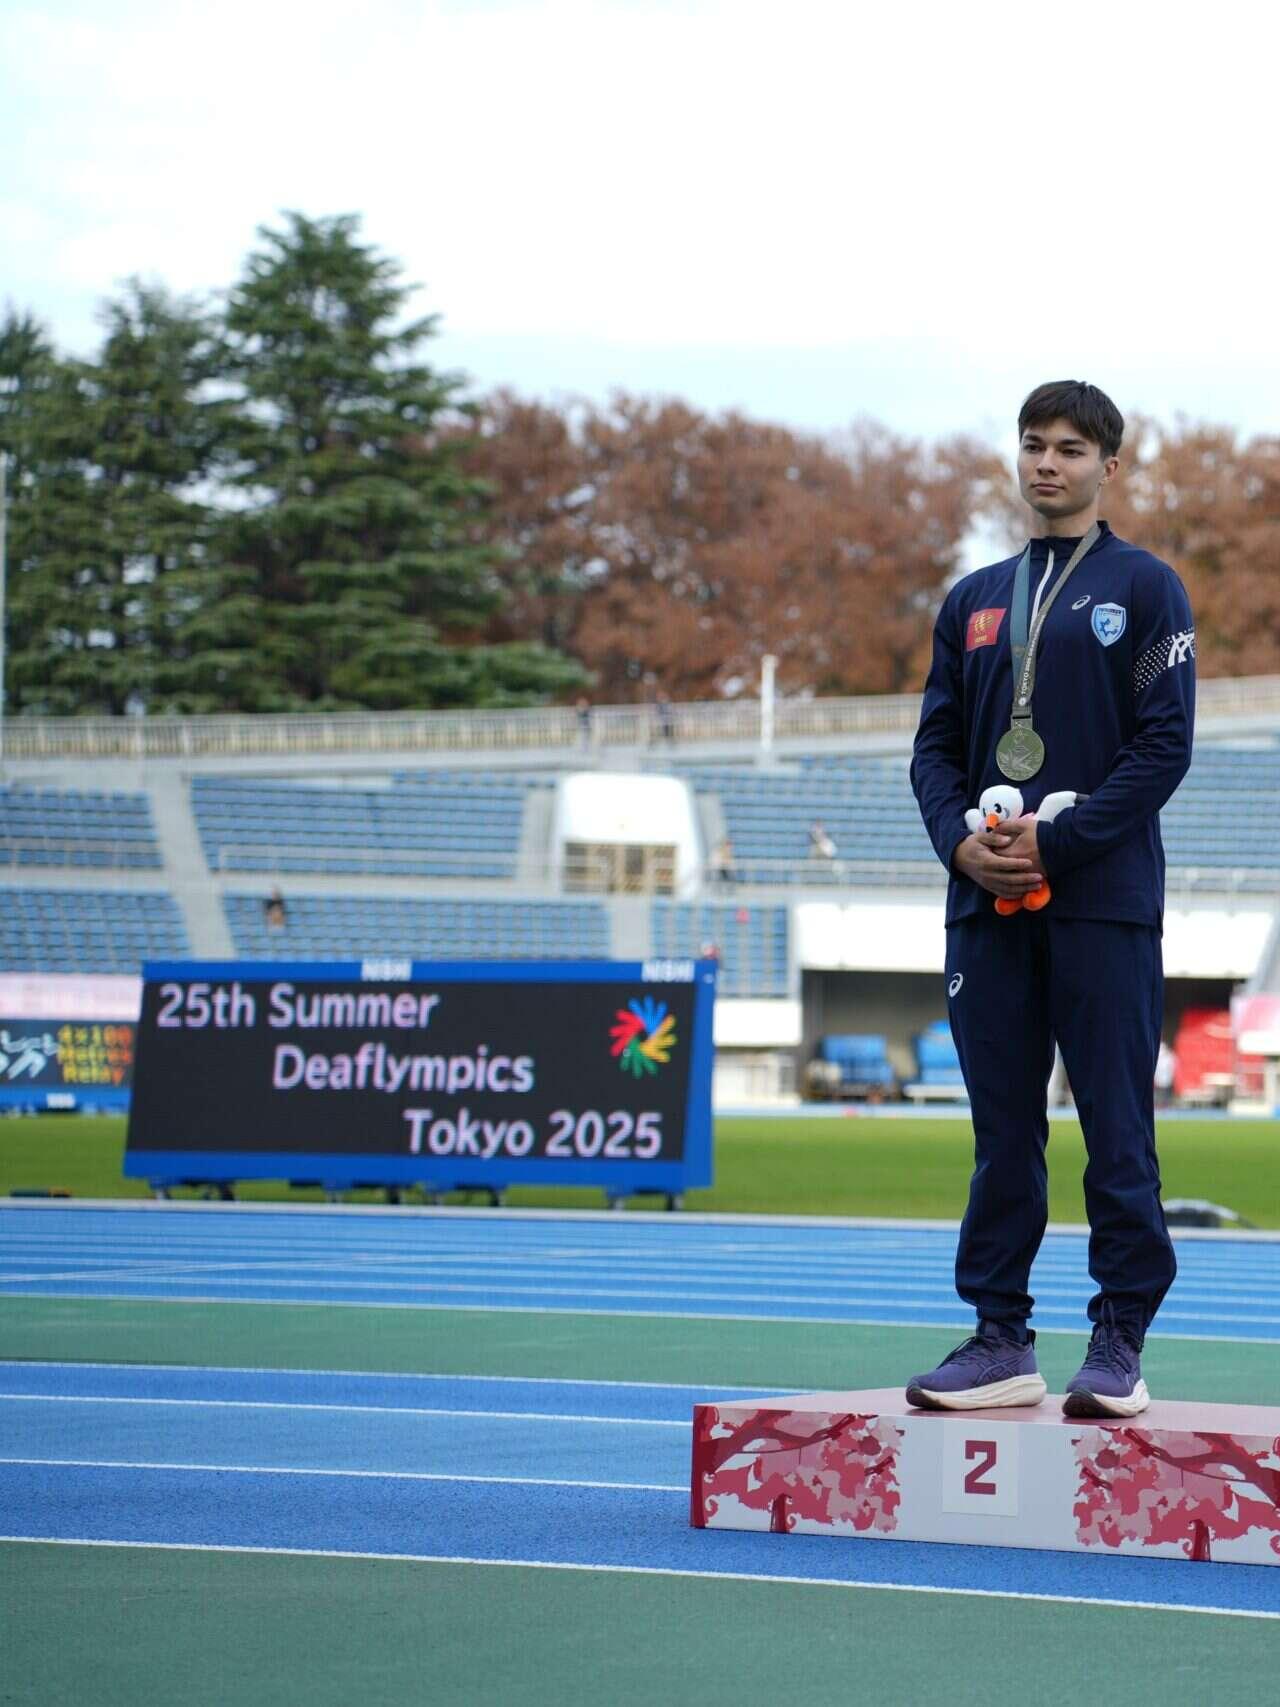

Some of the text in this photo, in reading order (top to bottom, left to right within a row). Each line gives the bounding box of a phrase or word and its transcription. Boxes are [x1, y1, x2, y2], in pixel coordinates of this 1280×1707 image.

[1021, 672, 1030, 696] TOKYO
[157, 982, 438, 1029] 25th Summer
[272, 1042, 534, 1094] Deaflympics
[403, 1107, 662, 1159] Tokyo 2025
[964, 1440, 997, 1495] 2
